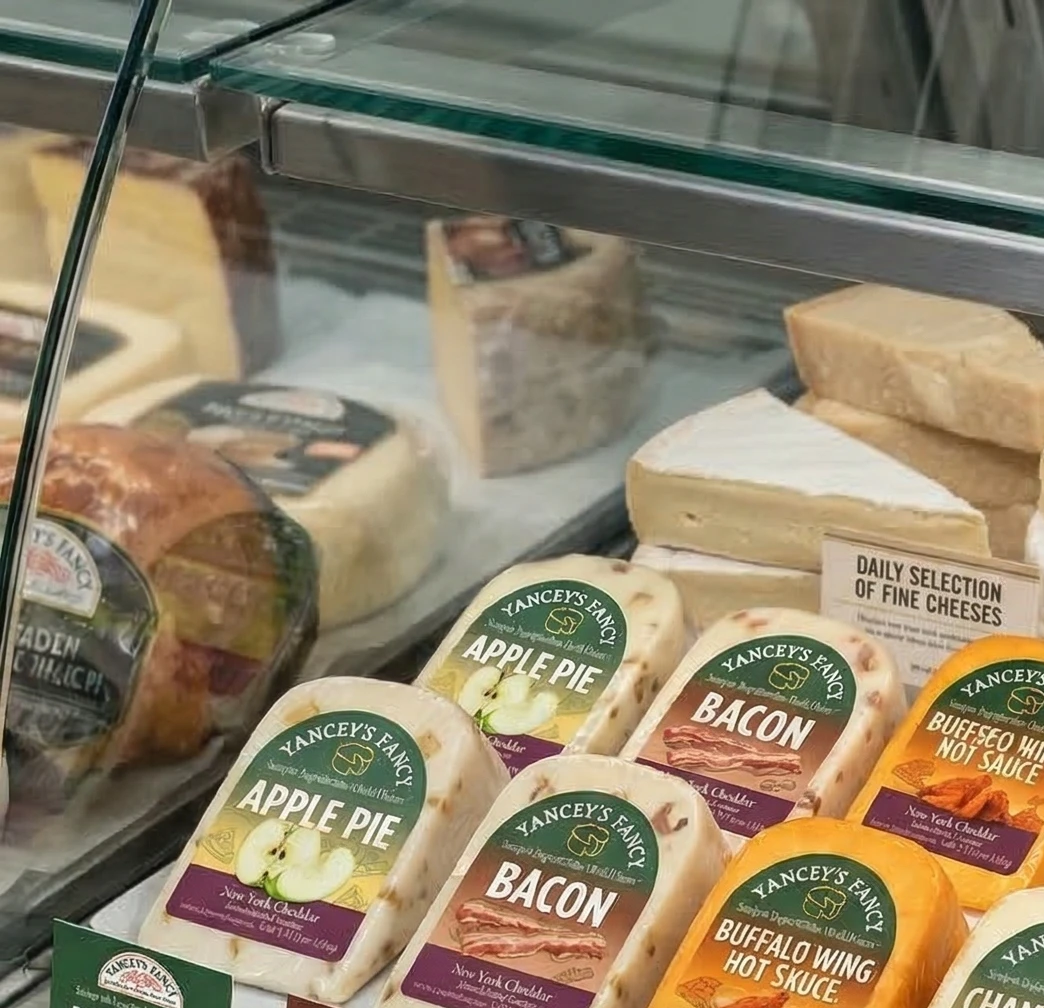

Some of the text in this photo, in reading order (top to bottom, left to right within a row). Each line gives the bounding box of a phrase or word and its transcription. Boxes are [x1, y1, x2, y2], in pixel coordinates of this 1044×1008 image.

[855, 579, 1002, 627] OF FINE CHEESES
[857, 555, 1002, 603] DAILY SELECTION
[462, 635, 554, 680] APPLE
[549, 658, 602, 694] PIE
[691, 692, 816, 750] BACON
[279, 722, 376, 757] YANCEY'S
[375, 732, 412, 787] FANCY
[935, 737, 1043, 785] NOT SAUCE
[236, 779, 344, 833] APPLE
[342, 807, 401, 850] PIE
[515, 803, 613, 837] YANCEY'S
[610, 814, 645, 869] FANCY
[485, 861, 618, 928] BACON
[751, 866, 849, 900] YANCEY'S
[714, 919, 807, 964] BUFFALO
[811, 944, 876, 983] WING
[723, 950, 770, 981] HOT
